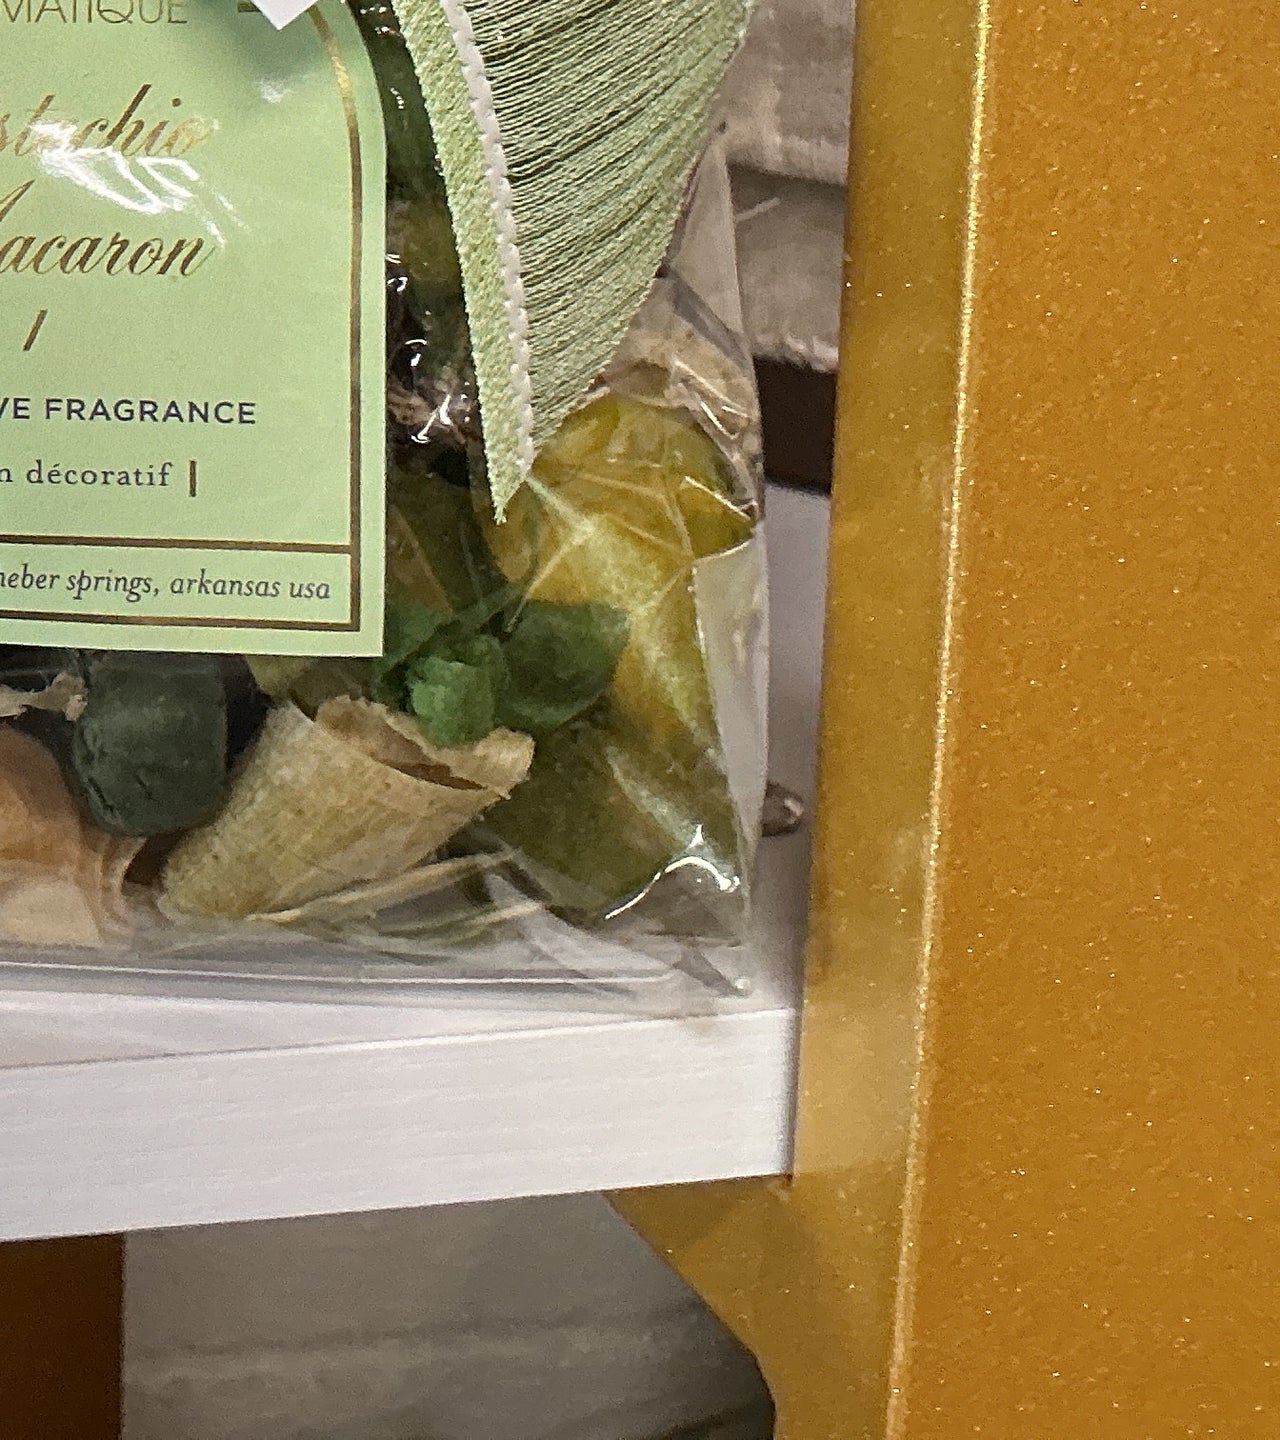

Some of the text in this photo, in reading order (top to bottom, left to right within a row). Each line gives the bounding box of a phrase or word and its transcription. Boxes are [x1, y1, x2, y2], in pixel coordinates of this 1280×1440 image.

[45, 397, 257, 426] FRAGRANCE
[25, 459, 173, 489] décoratif
[65, 567, 160, 603] springs,
[170, 573, 281, 600] arkansas
[287, 580, 331, 601] usa
